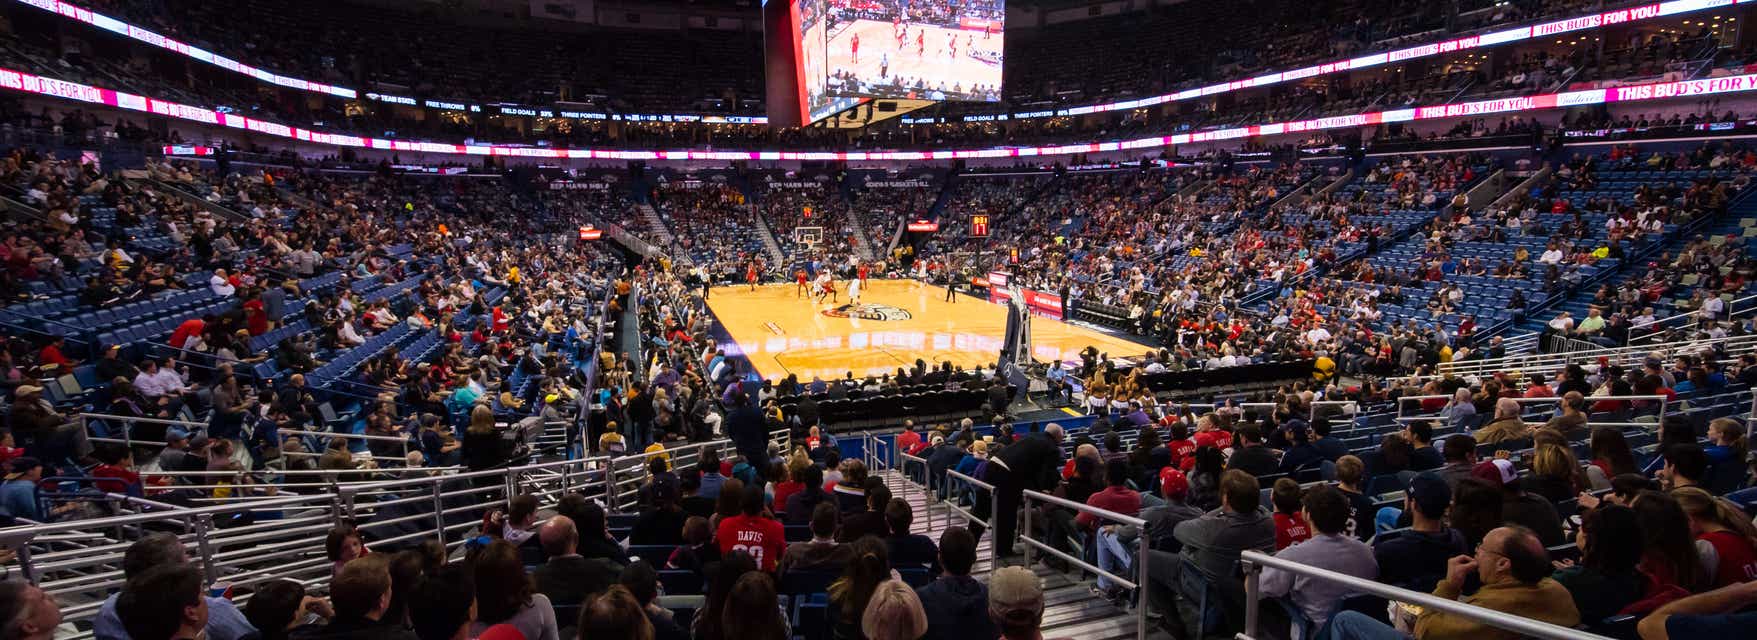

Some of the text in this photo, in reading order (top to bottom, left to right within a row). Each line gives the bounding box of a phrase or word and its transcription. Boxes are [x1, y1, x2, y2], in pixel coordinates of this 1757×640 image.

[1540, 4, 1660, 34] THIS BUD'S FOR YOU.
[1394, 49, 1411, 61] THIS
[1413, 44, 1438, 57] BUD'S
[1440, 41, 1456, 53] FOR
[0, 70, 21, 89] HIS
[22, 75, 57, 95] BUD'S
[60, 82, 78, 98] FOR
[1617, 85, 1650, 101] THIS
[1654, 79, 1704, 98] BUD'S
[1708, 76, 1742, 92] FOR
[1422, 105, 1444, 118] THIS
[1448, 102, 1480, 115] BUD'S
[1482, 100, 1504, 112] FOR
[1508, 97, 1535, 110] YOU.
[1289, 121, 1304, 131] THIS
[1306, 118, 1328, 130] BUD'S
[1331, 117, 1346, 127] FOR
[737, 530, 763, 543] DAVIS
